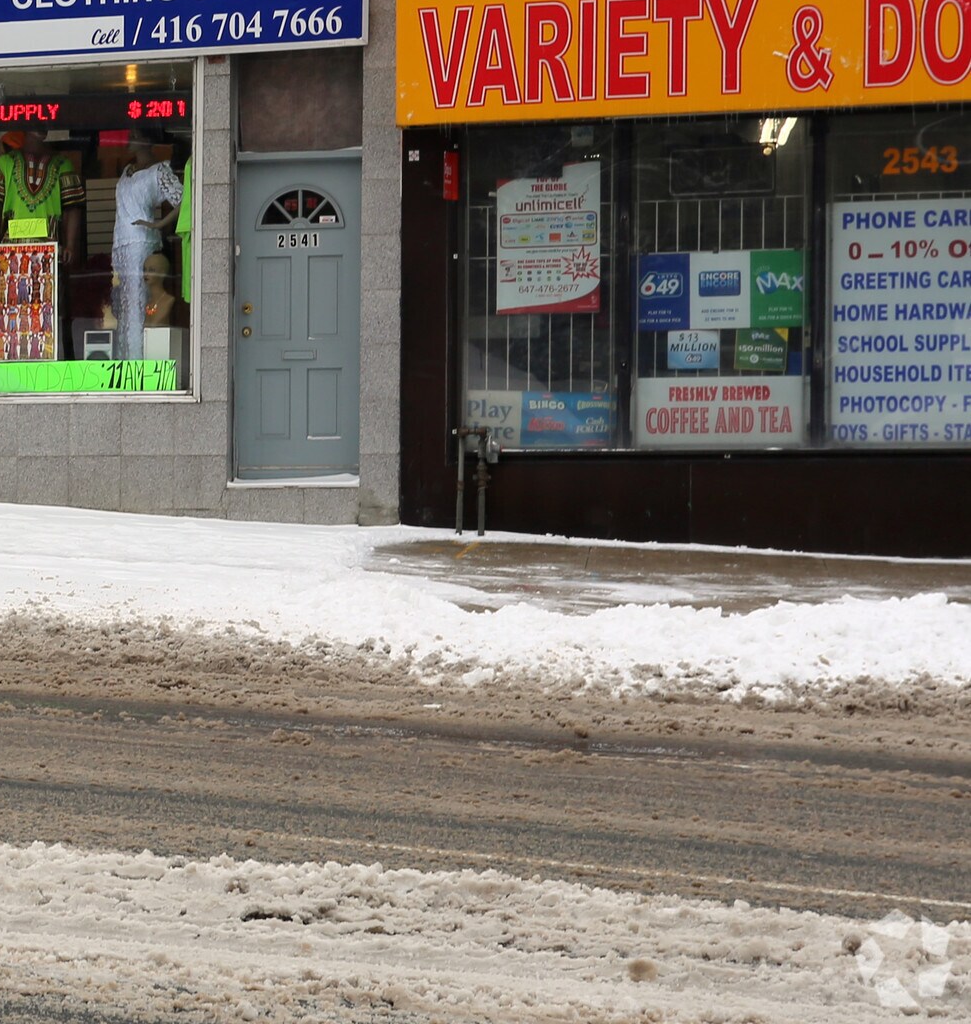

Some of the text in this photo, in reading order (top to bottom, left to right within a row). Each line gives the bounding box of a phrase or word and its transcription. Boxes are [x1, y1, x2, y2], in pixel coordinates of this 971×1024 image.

[91, 28, 120, 46] Cell
[151, 14, 202, 43] 416
[212, 9, 263, 40] 704
[273, 6, 343, 37] 7666
[785, 5, 835, 93] &
[883, 145, 960, 175] 2543
[531, 183, 568, 193] THE GLOBE
[516, 196, 582, 212] unlimicell
[842, 209, 971, 230] PHONE CAR
[278, 233, 318, 248] 2541
[848, 242, 862, 260] 0
[890, 239, 939, 259] 10%
[948, 239, 971, 259] O
[640, 274, 680, 296] 649
[700, 272, 740, 281] ENCORE
[840, 272, 931, 291] GREETING
[833, 304, 888, 322] HOME
[670, 342, 717, 352] MILLION
[754, 344, 783, 353] million
[838, 334, 971, 353] SCHOOL SUPPL
[834, 365, 942, 383] HOUSEHOLD
[669, 385, 771, 402] FRESHLY BREWED
[468, 399, 513, 423] Play
[529, 400, 565, 410] BINGO
[840, 395, 947, 413] PHOTOCOPY
[645, 406, 792, 434] COFFEE AND TEA
[882, 424, 929, 441] GIFTS
